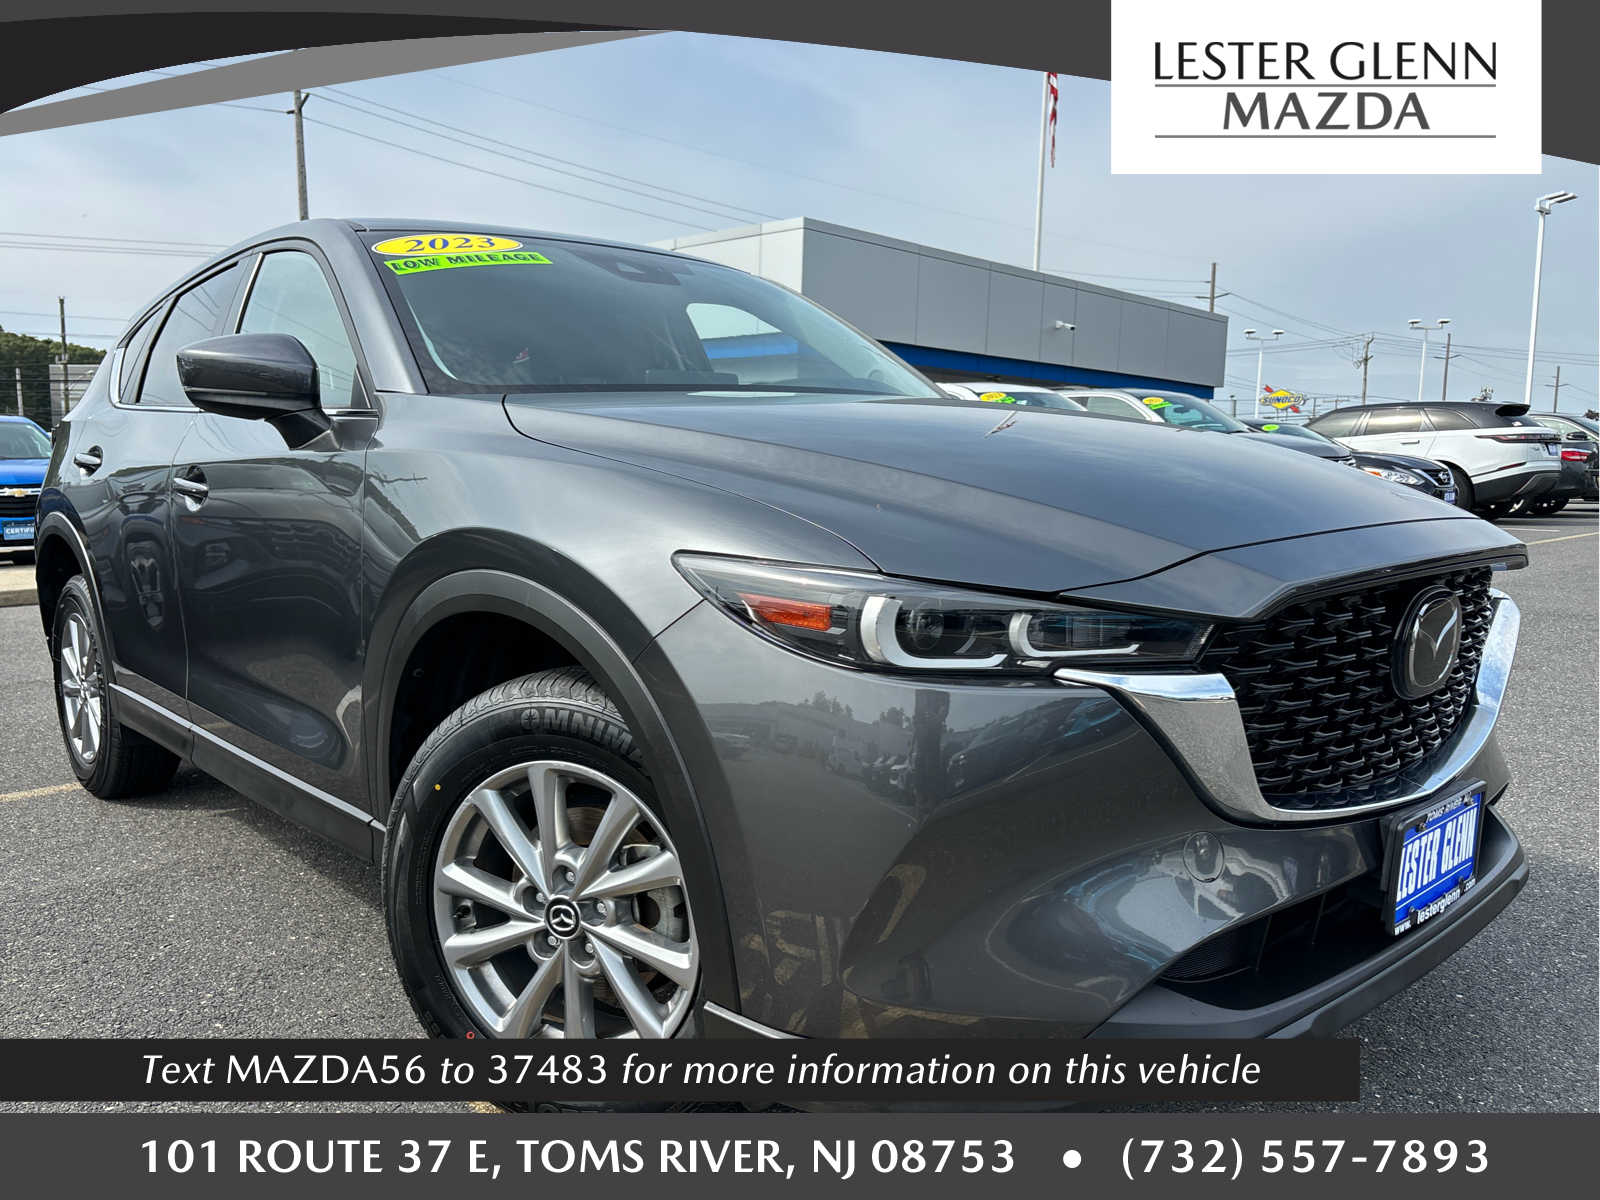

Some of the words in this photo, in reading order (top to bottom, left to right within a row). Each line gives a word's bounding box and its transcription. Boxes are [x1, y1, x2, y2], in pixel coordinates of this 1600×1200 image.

[405, 237, 496, 253] 2023
[391, 257, 437, 271] LOW
[446, 253, 542, 265] MILEAGE
[1259, 393, 1306, 406] SUNOCO
[1396, 828, 1442, 902] LESTER
[1441, 807, 1477, 874] GLENN
[1417, 889, 1460, 924] lesterglenn
